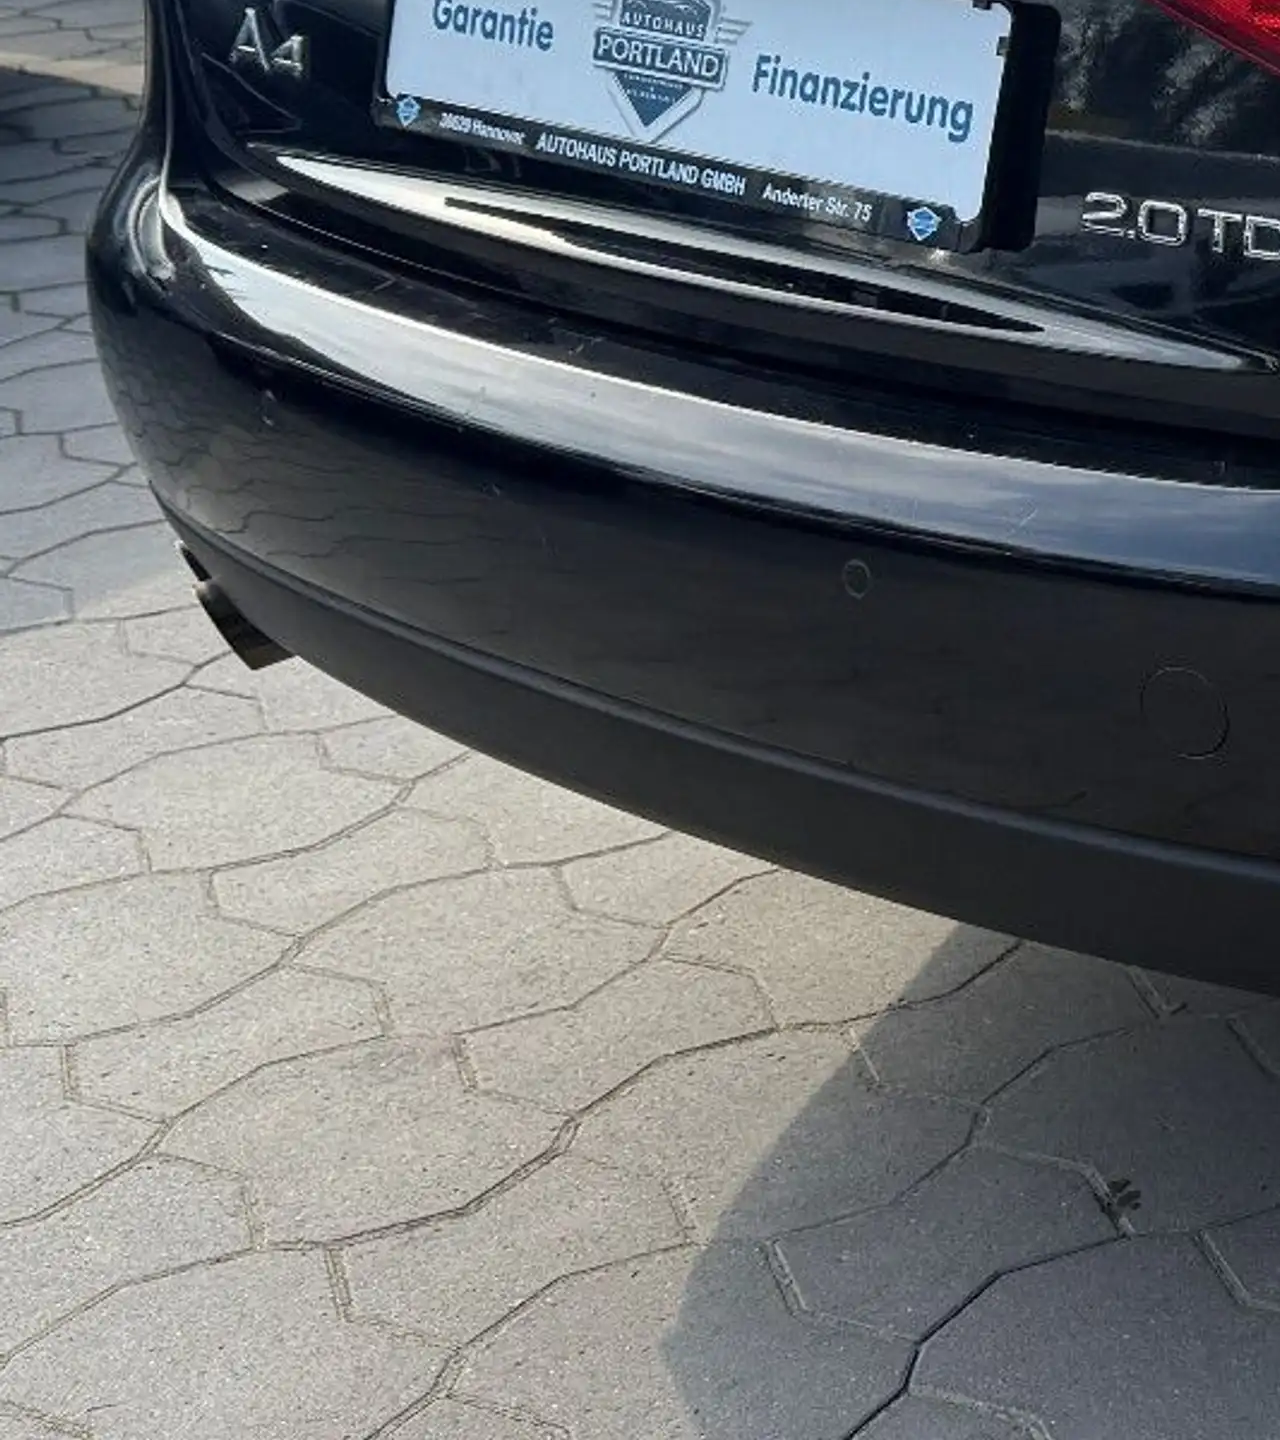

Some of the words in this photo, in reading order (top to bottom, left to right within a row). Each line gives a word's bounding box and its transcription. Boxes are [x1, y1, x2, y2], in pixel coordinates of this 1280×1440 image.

[229, 7, 303, 78] A4
[597, 33, 719, 77] PORTLAND
[621, 11, 705, 38] AUTOHAUS
[752, 54, 974, 143] Finanzierung
[536, 132, 617, 168] AUTOHAUS
[618, 150, 699, 185] PORTLAND
[825, 196, 851, 218] Str.
